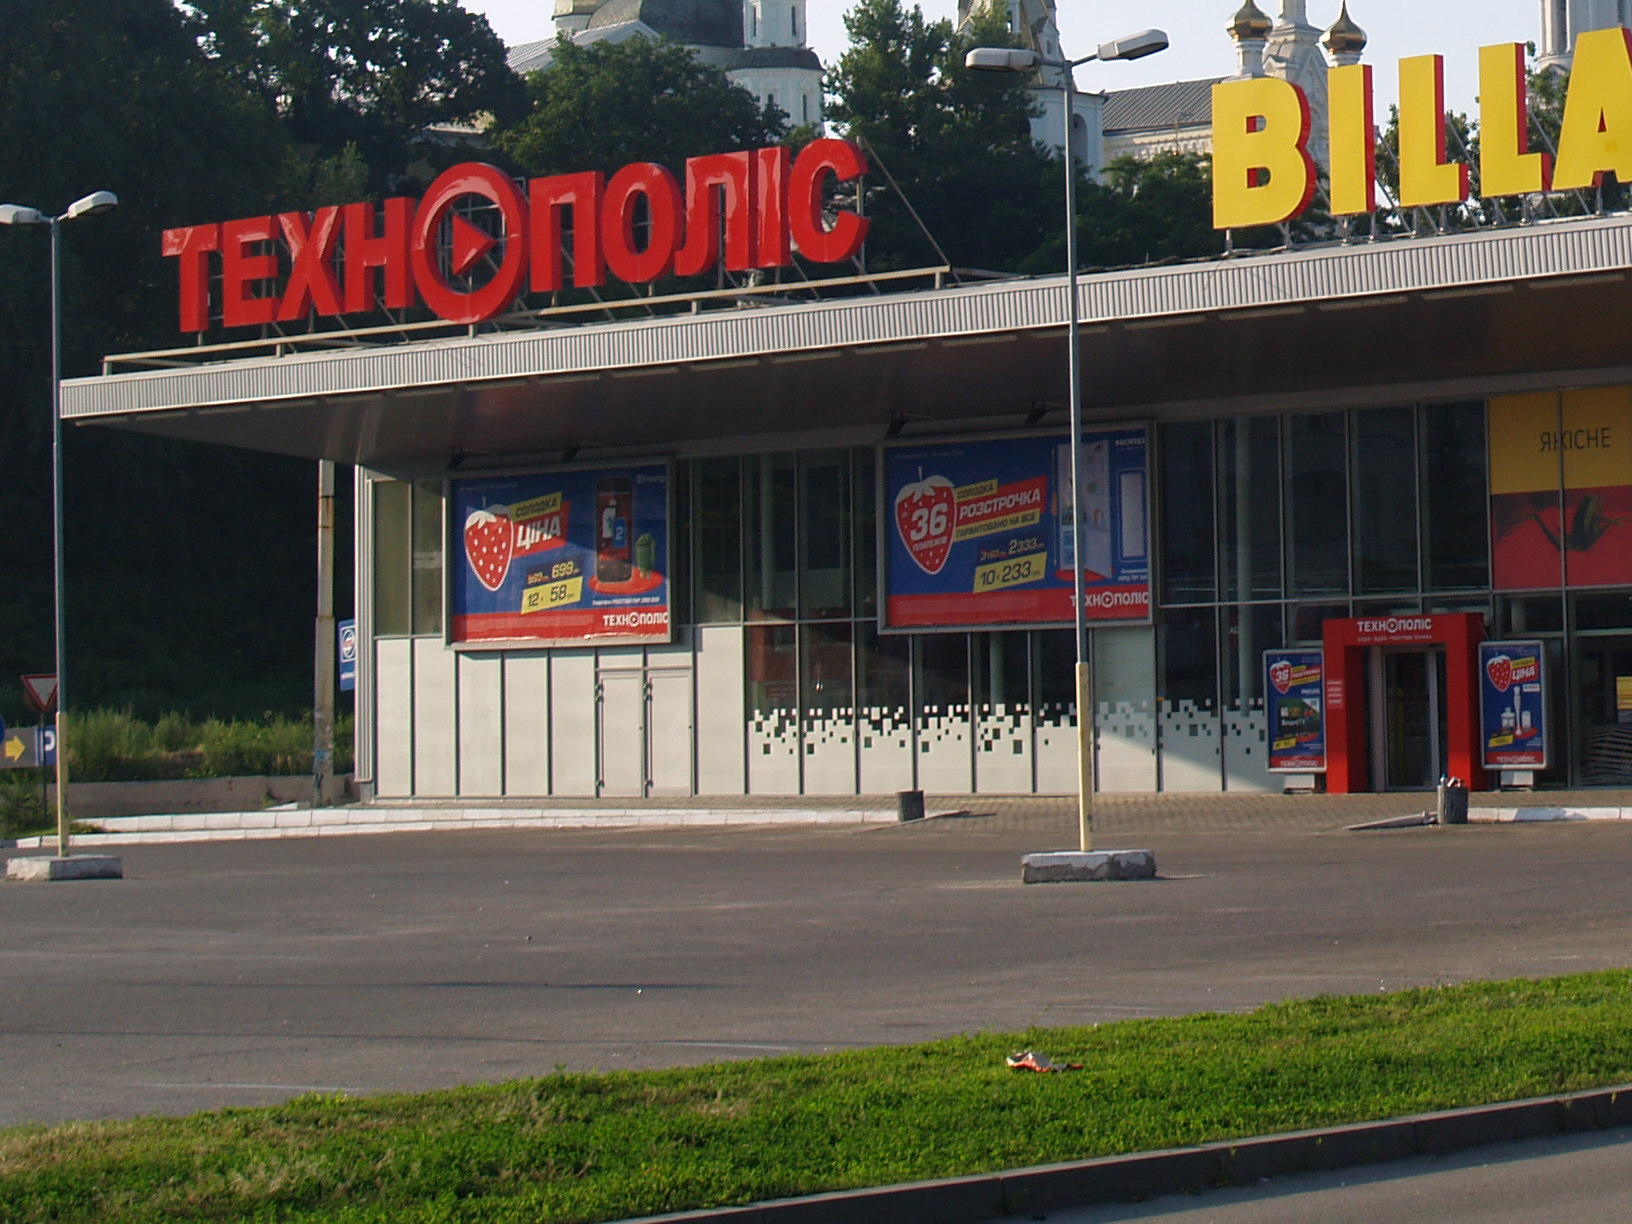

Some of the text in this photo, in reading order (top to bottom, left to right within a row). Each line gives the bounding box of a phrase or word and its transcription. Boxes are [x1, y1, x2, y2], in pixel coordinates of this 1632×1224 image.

[161, 138, 870, 333] ТЕХНОПОЛІС
[1540, 427, 1612, 452] ЯКІСНЕ
[515, 497, 559, 518] СОЛОДКА
[959, 487, 1041, 520] РОЗСТРОЧКА
[516, 515, 562, 549] ЦІНА
[910, 502, 948, 541] 36
[552, 560, 574, 578] 699
[980, 560, 1032, 586] 10 233
[527, 584, 567, 607] 12 58
[1069, 591, 1149, 608] ТХНОПОЛІС
[1356, 618, 1432, 633] ТЕХНОПОЛІС
[1275, 669, 1289, 683] 36
[1512, 666, 1535, 680] ЦІНА
